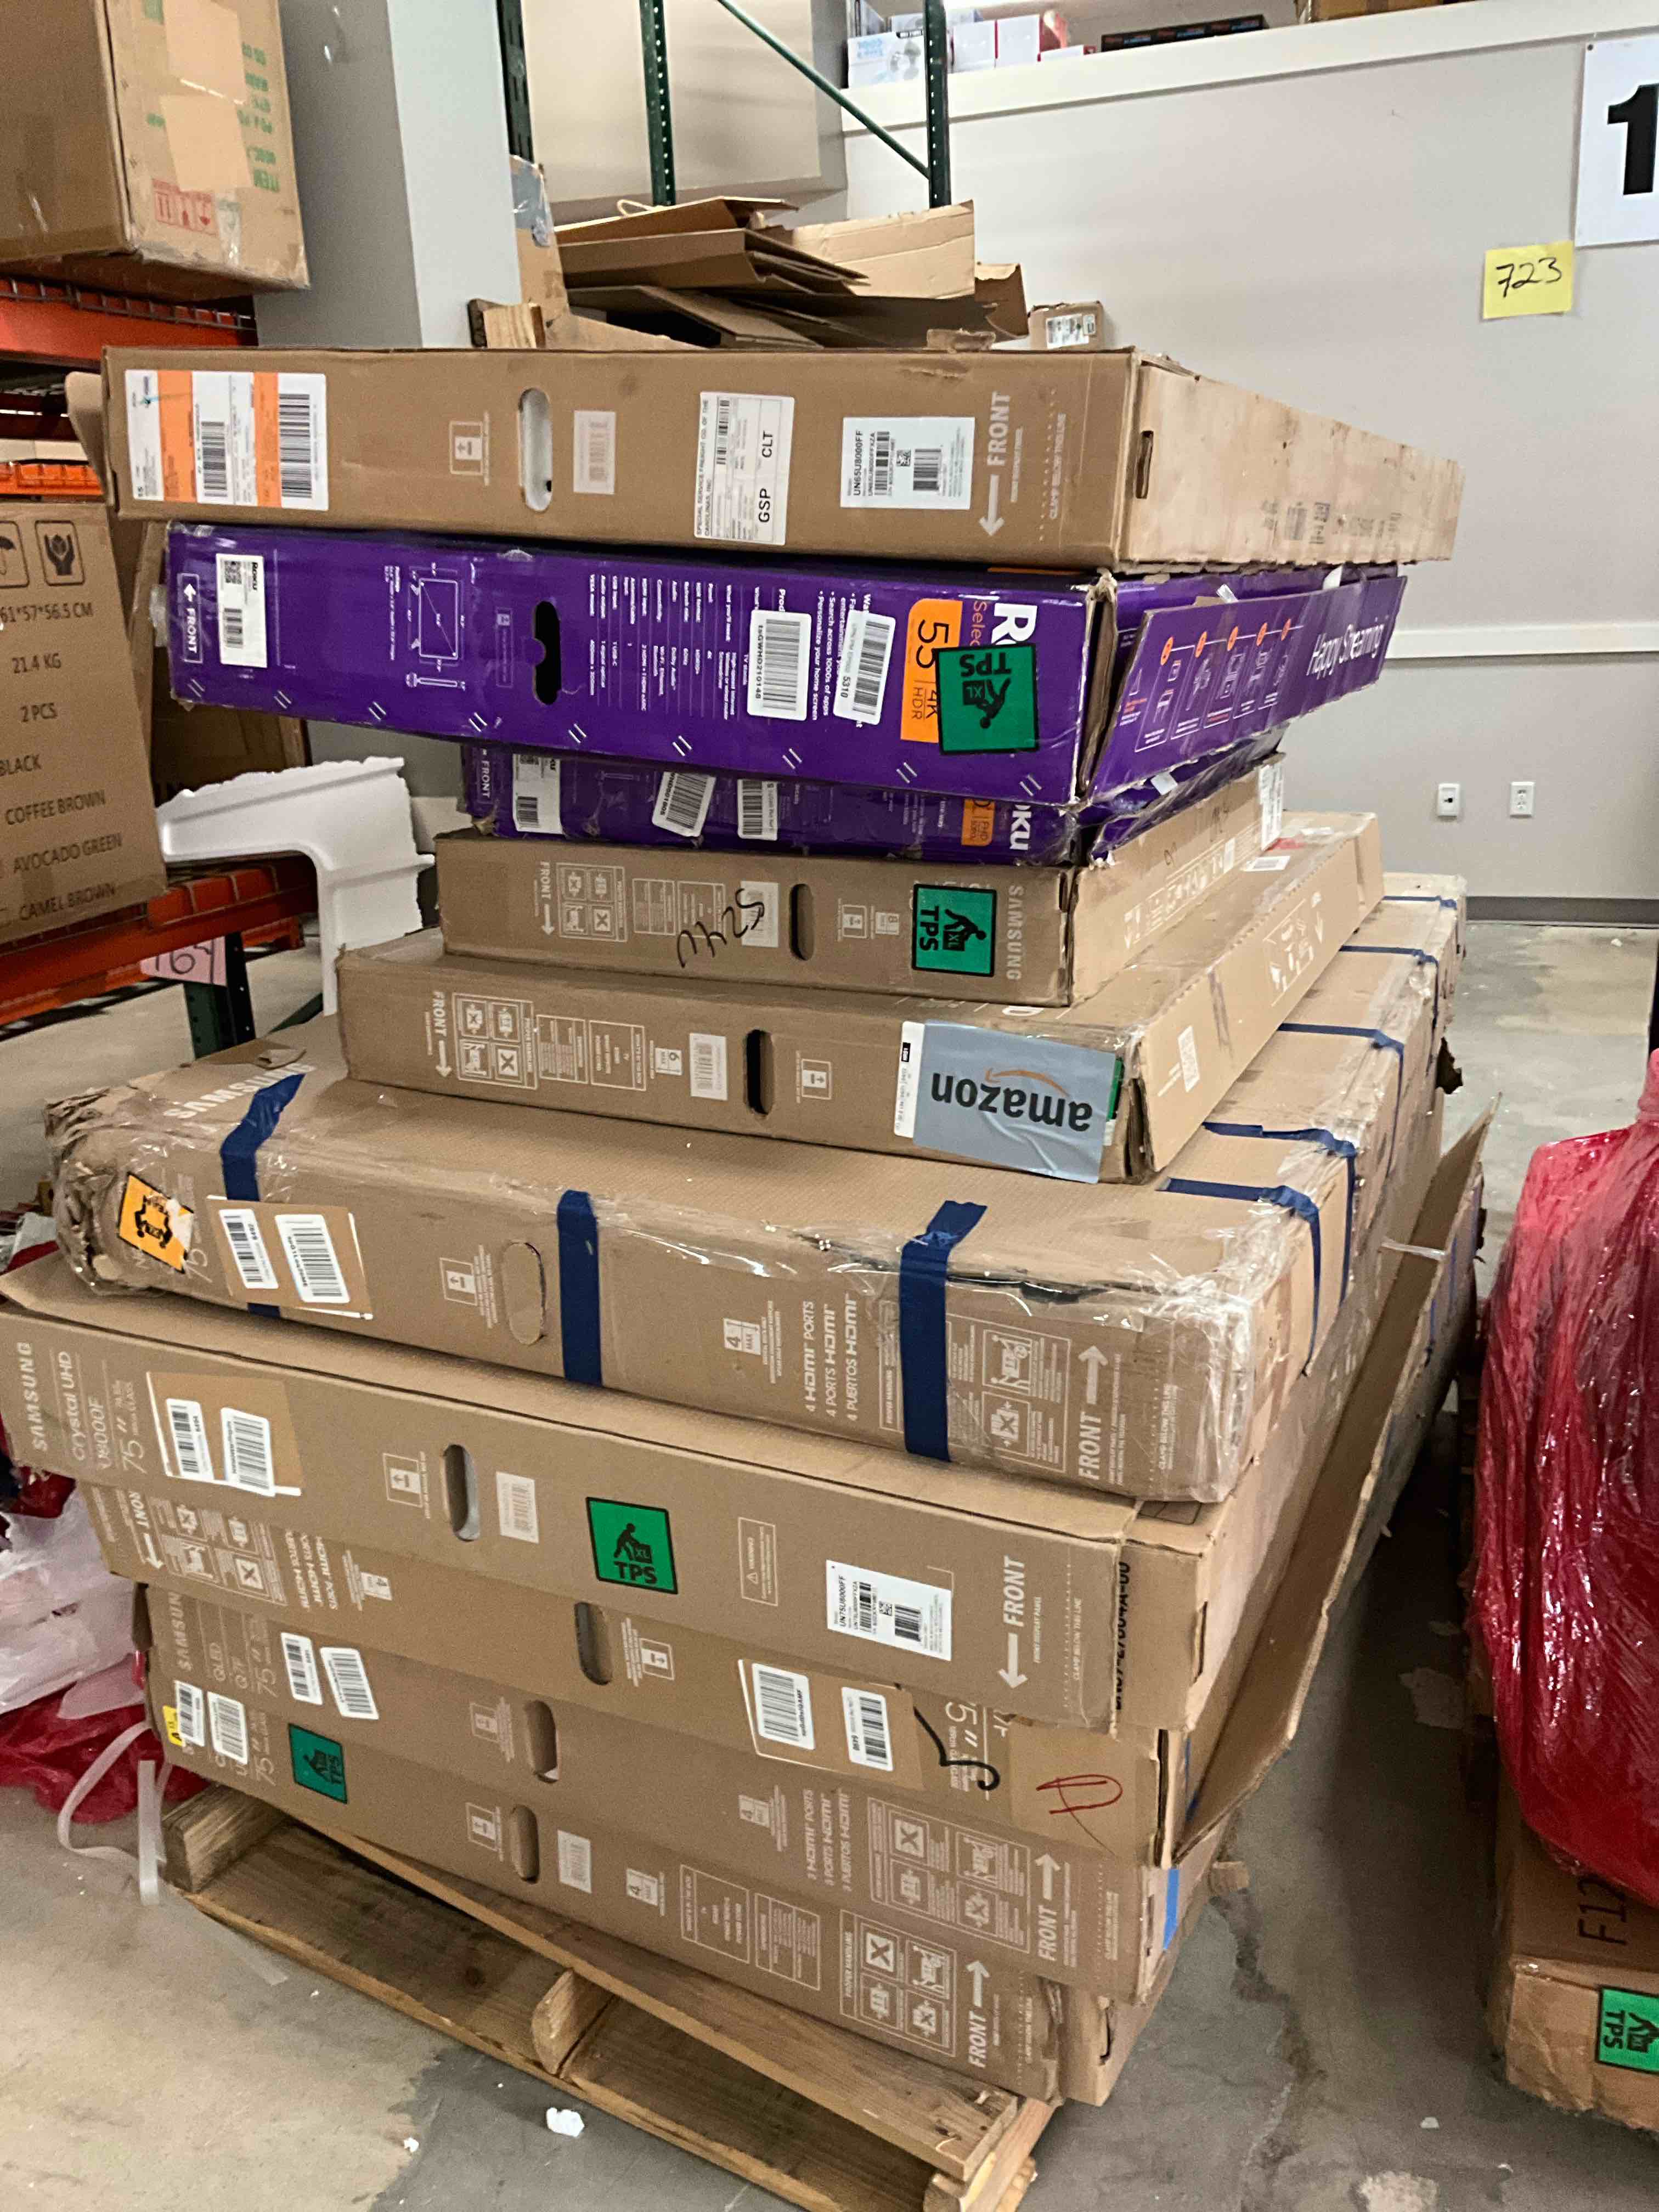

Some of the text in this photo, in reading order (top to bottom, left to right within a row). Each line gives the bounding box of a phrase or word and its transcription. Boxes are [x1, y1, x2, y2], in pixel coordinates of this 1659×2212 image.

[1496, 256, 1562, 298] 723
[761, 431, 772, 458] CLT
[987, 391, 1011, 466] FRONT
[758, 488, 771, 523] GSP
[74, 602, 94, 618] CM
[183, 608, 198, 653] FRONT
[815, 596, 825, 645] Personalize
[827, 597, 836, 627] Search
[12, 653, 62, 674] 21.4 KG
[825, 658, 833, 683] 1000s
[960, 652, 1012, 678] TPS
[1306, 633, 1344, 680] Happy
[813, 668, 821, 691] home
[840, 676, 851, 698] 5310
[21, 703, 58, 723] 2 PCS
[912, 687, 923, 720] HDR
[482, 760, 491, 798] FRONT
[5, 789, 106, 826] COFFEE BROWN
[13, 832, 122, 873] AVOCADO GREEN
[540, 861, 551, 900] FRONT
[18, 883, 116, 922] CAMEL BROWN
[919, 905, 939, 952] TPS
[948, 933, 960, 948] XL
[1006, 885, 1025, 981] SAMSUNG
[432, 991, 448, 1037] FRONT
[931, 1072, 1093, 1132] amazon
[803, 1300, 814, 1341] PORTS
[726, 1335, 741, 1348] 4
[824, 1304, 836, 1418] 4 PORTS HDMI
[845, 1293, 857, 1421] 4 PUERTOS HDMI
[804, 1344, 816, 1402] HDMI
[16, 1342, 48, 1451] SAMSUNG
[58, 1351, 87, 1461] Crystal UHD
[88, 1396, 113, 1469] U8000F
[1078, 1412, 1102, 1480] FRONT
[128, 1490, 149, 1528] RONT
[613, 1561, 657, 1584] TPS
[1003, 1555, 1025, 1627] FRONT
[168, 1592, 193, 1672] SAMSUN
[210, 1642, 226, 1681] QLED
[1039, 1905, 1058, 1960] FRONT
[968, 2010, 986, 2068] FRONT
[1604, 2011, 1625, 2050] TPS
